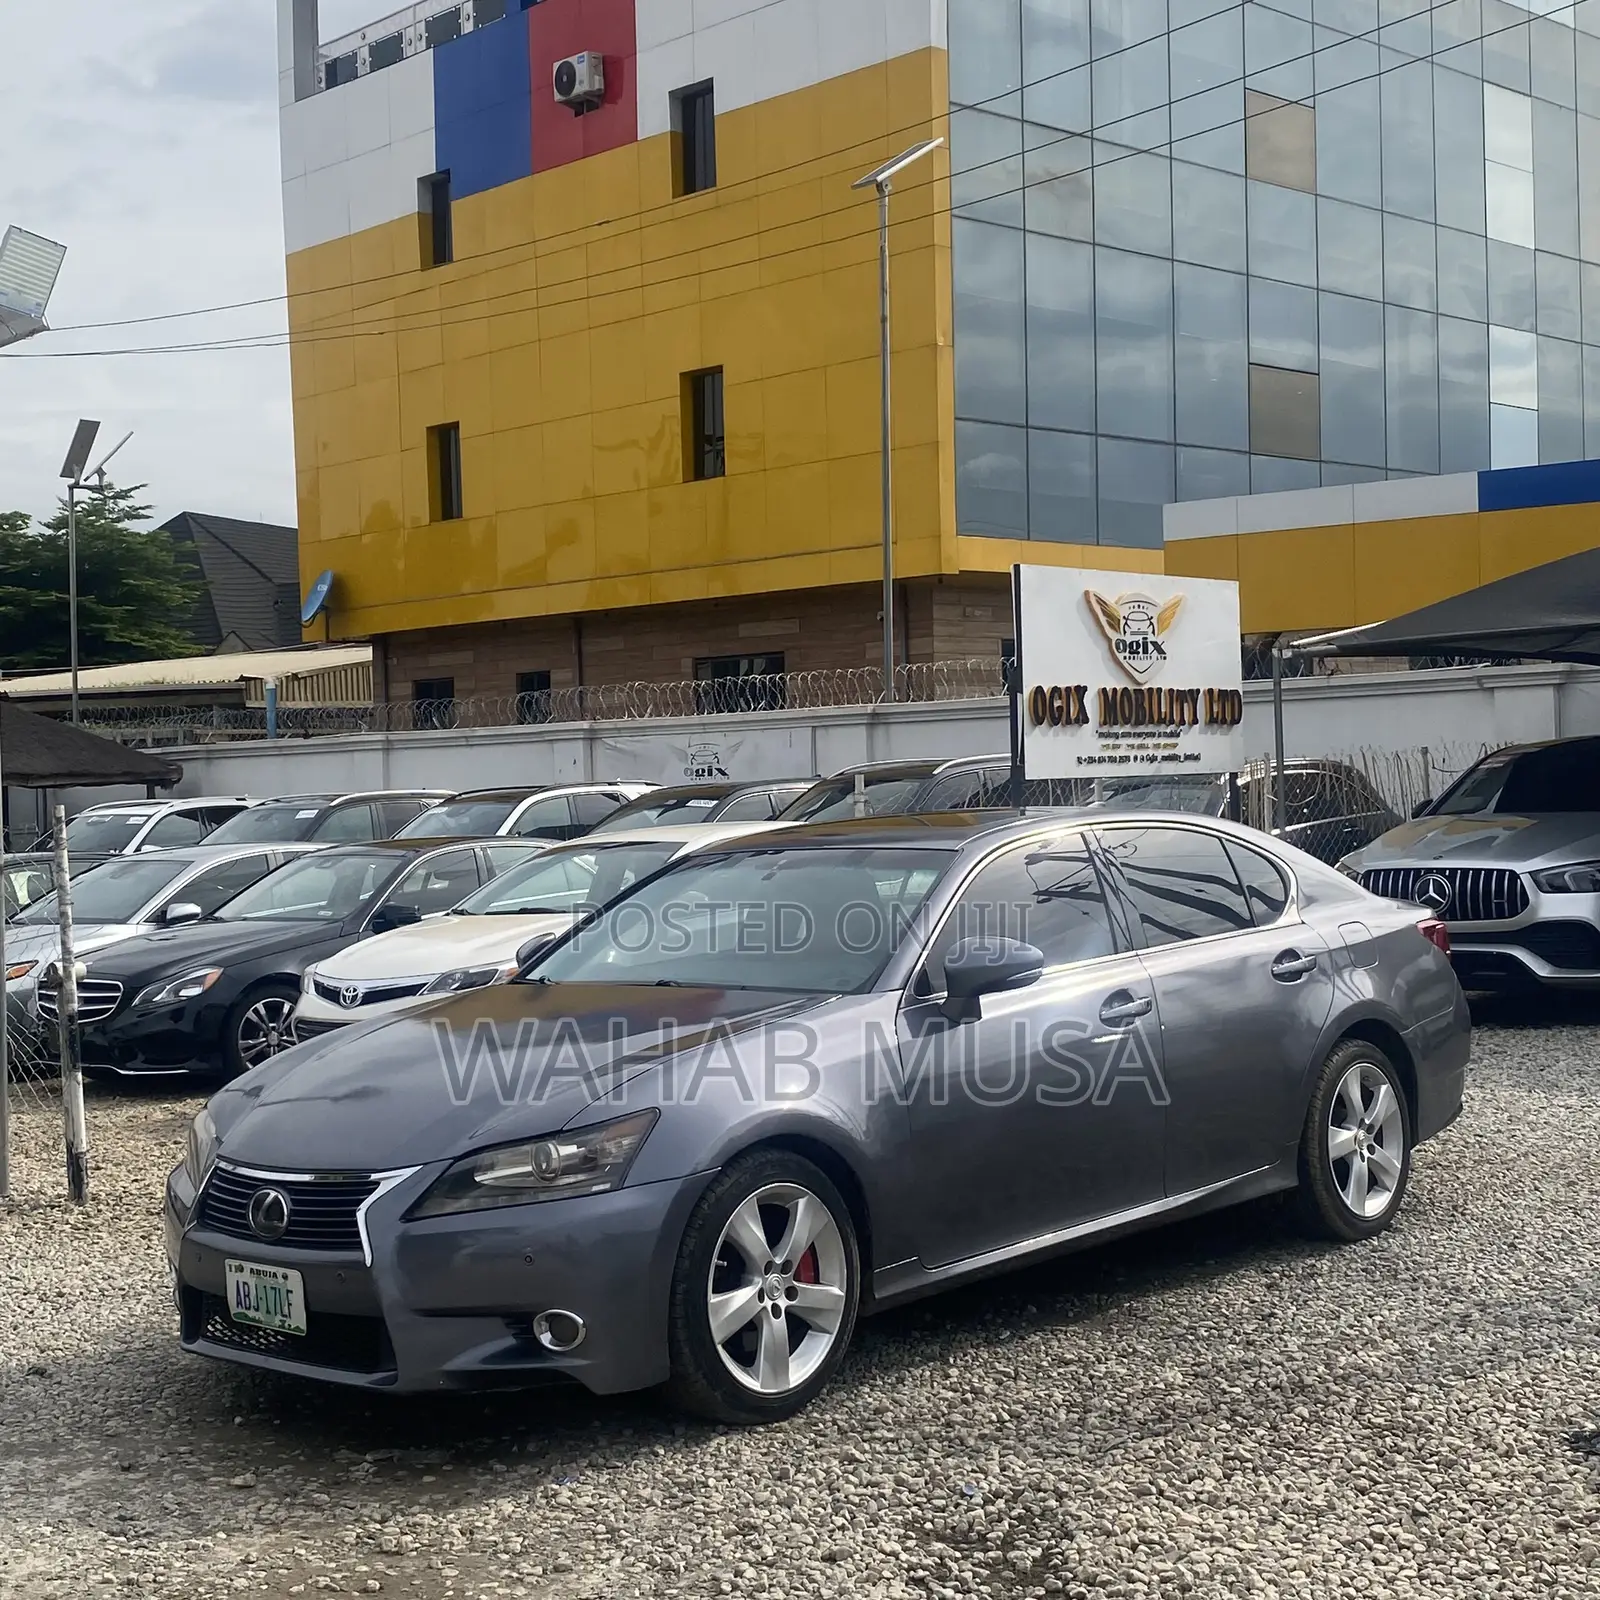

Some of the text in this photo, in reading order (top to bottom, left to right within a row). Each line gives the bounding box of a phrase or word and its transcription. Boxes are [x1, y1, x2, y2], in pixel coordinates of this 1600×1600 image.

[1029, 685, 1243, 726] OGIX MOBILITY LTD
[249, 1267, 278, 1279] ABUJA
[236, 1279, 293, 1320] ABJ-17LF
